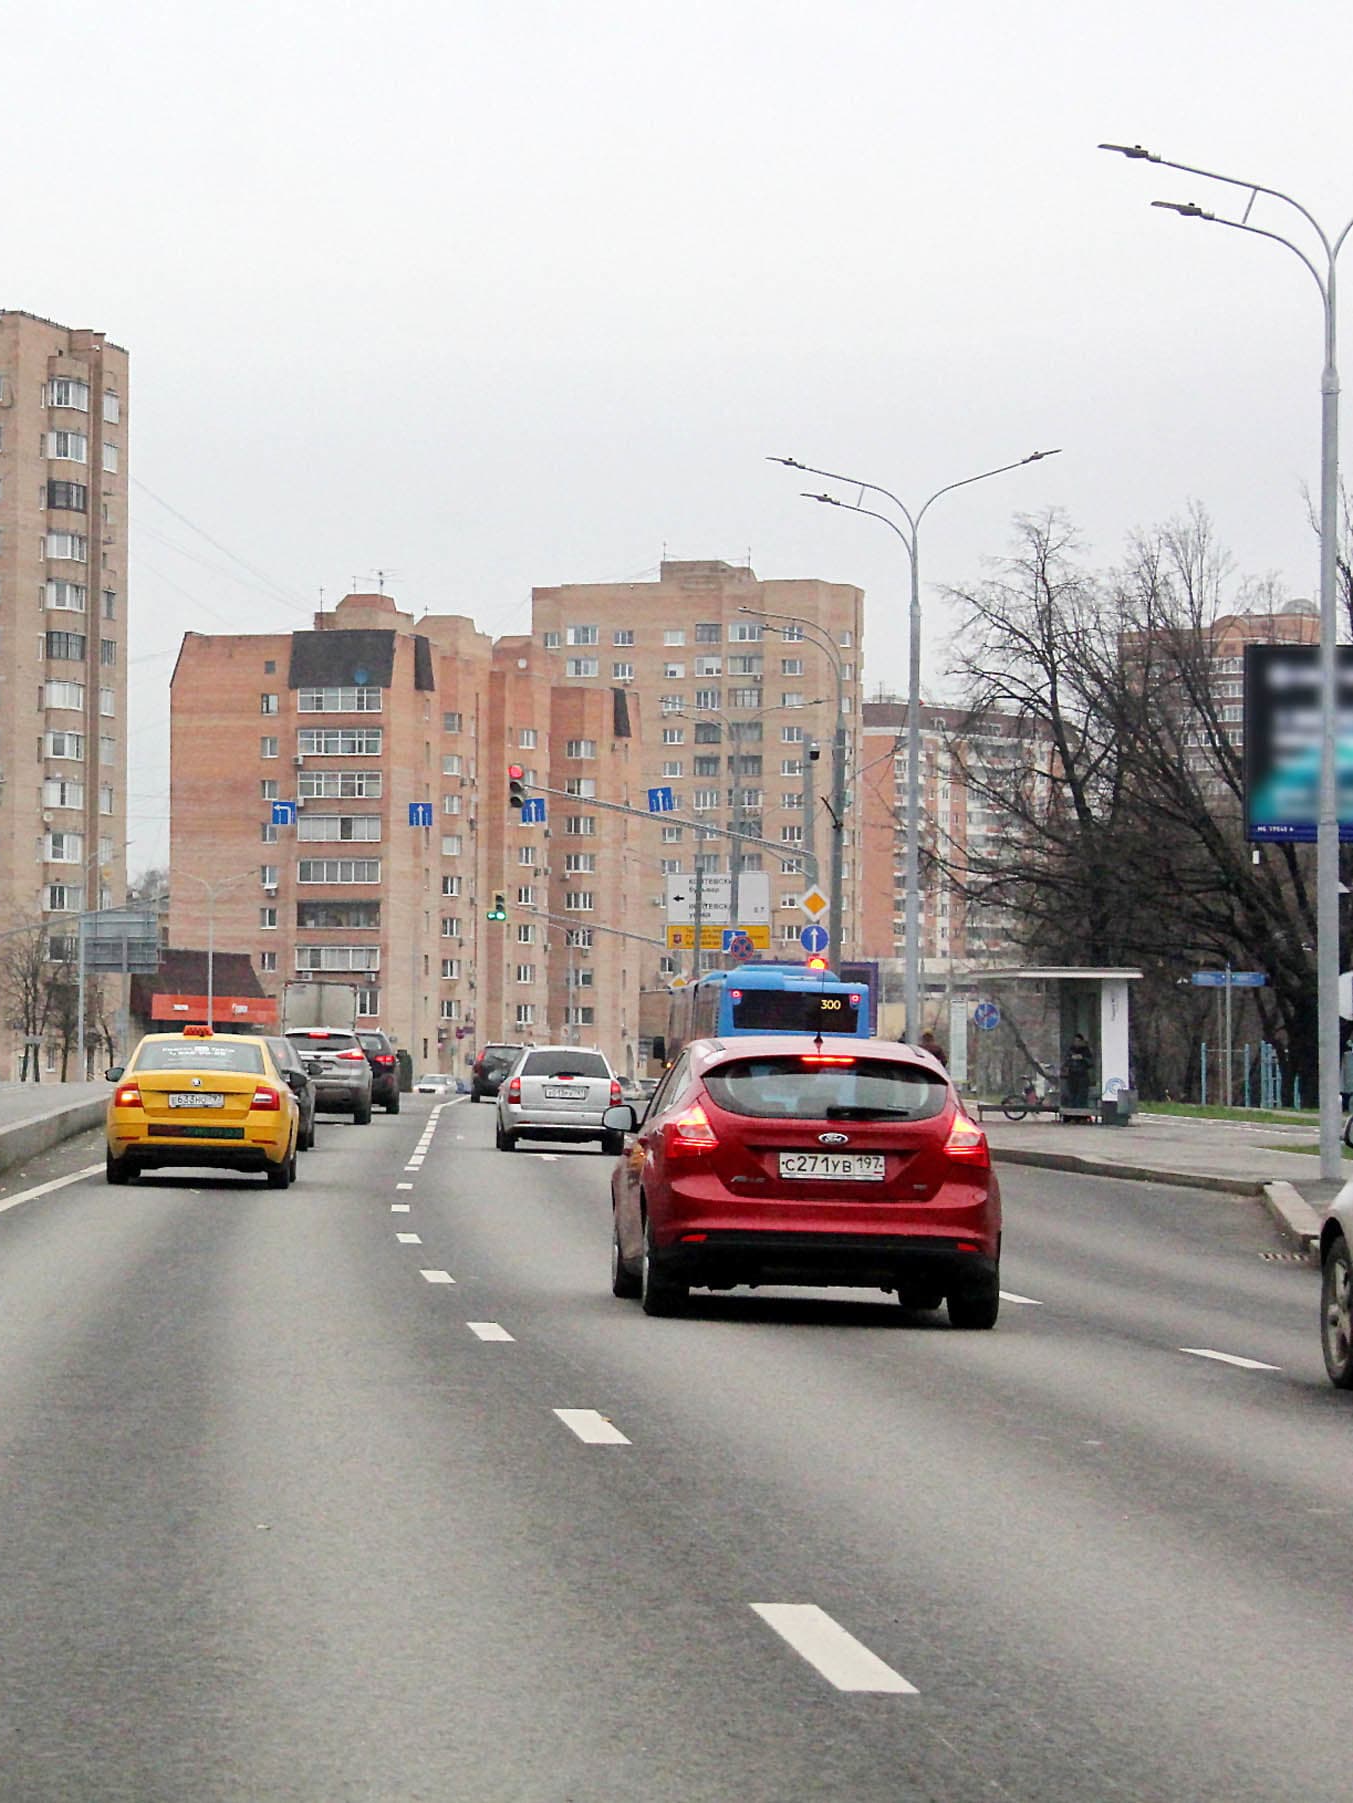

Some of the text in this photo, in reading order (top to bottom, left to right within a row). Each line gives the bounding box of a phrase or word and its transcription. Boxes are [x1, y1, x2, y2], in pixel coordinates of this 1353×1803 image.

[820, 999, 841, 1010] 300
[785, 1155, 881, 1173] С271УВ 197
